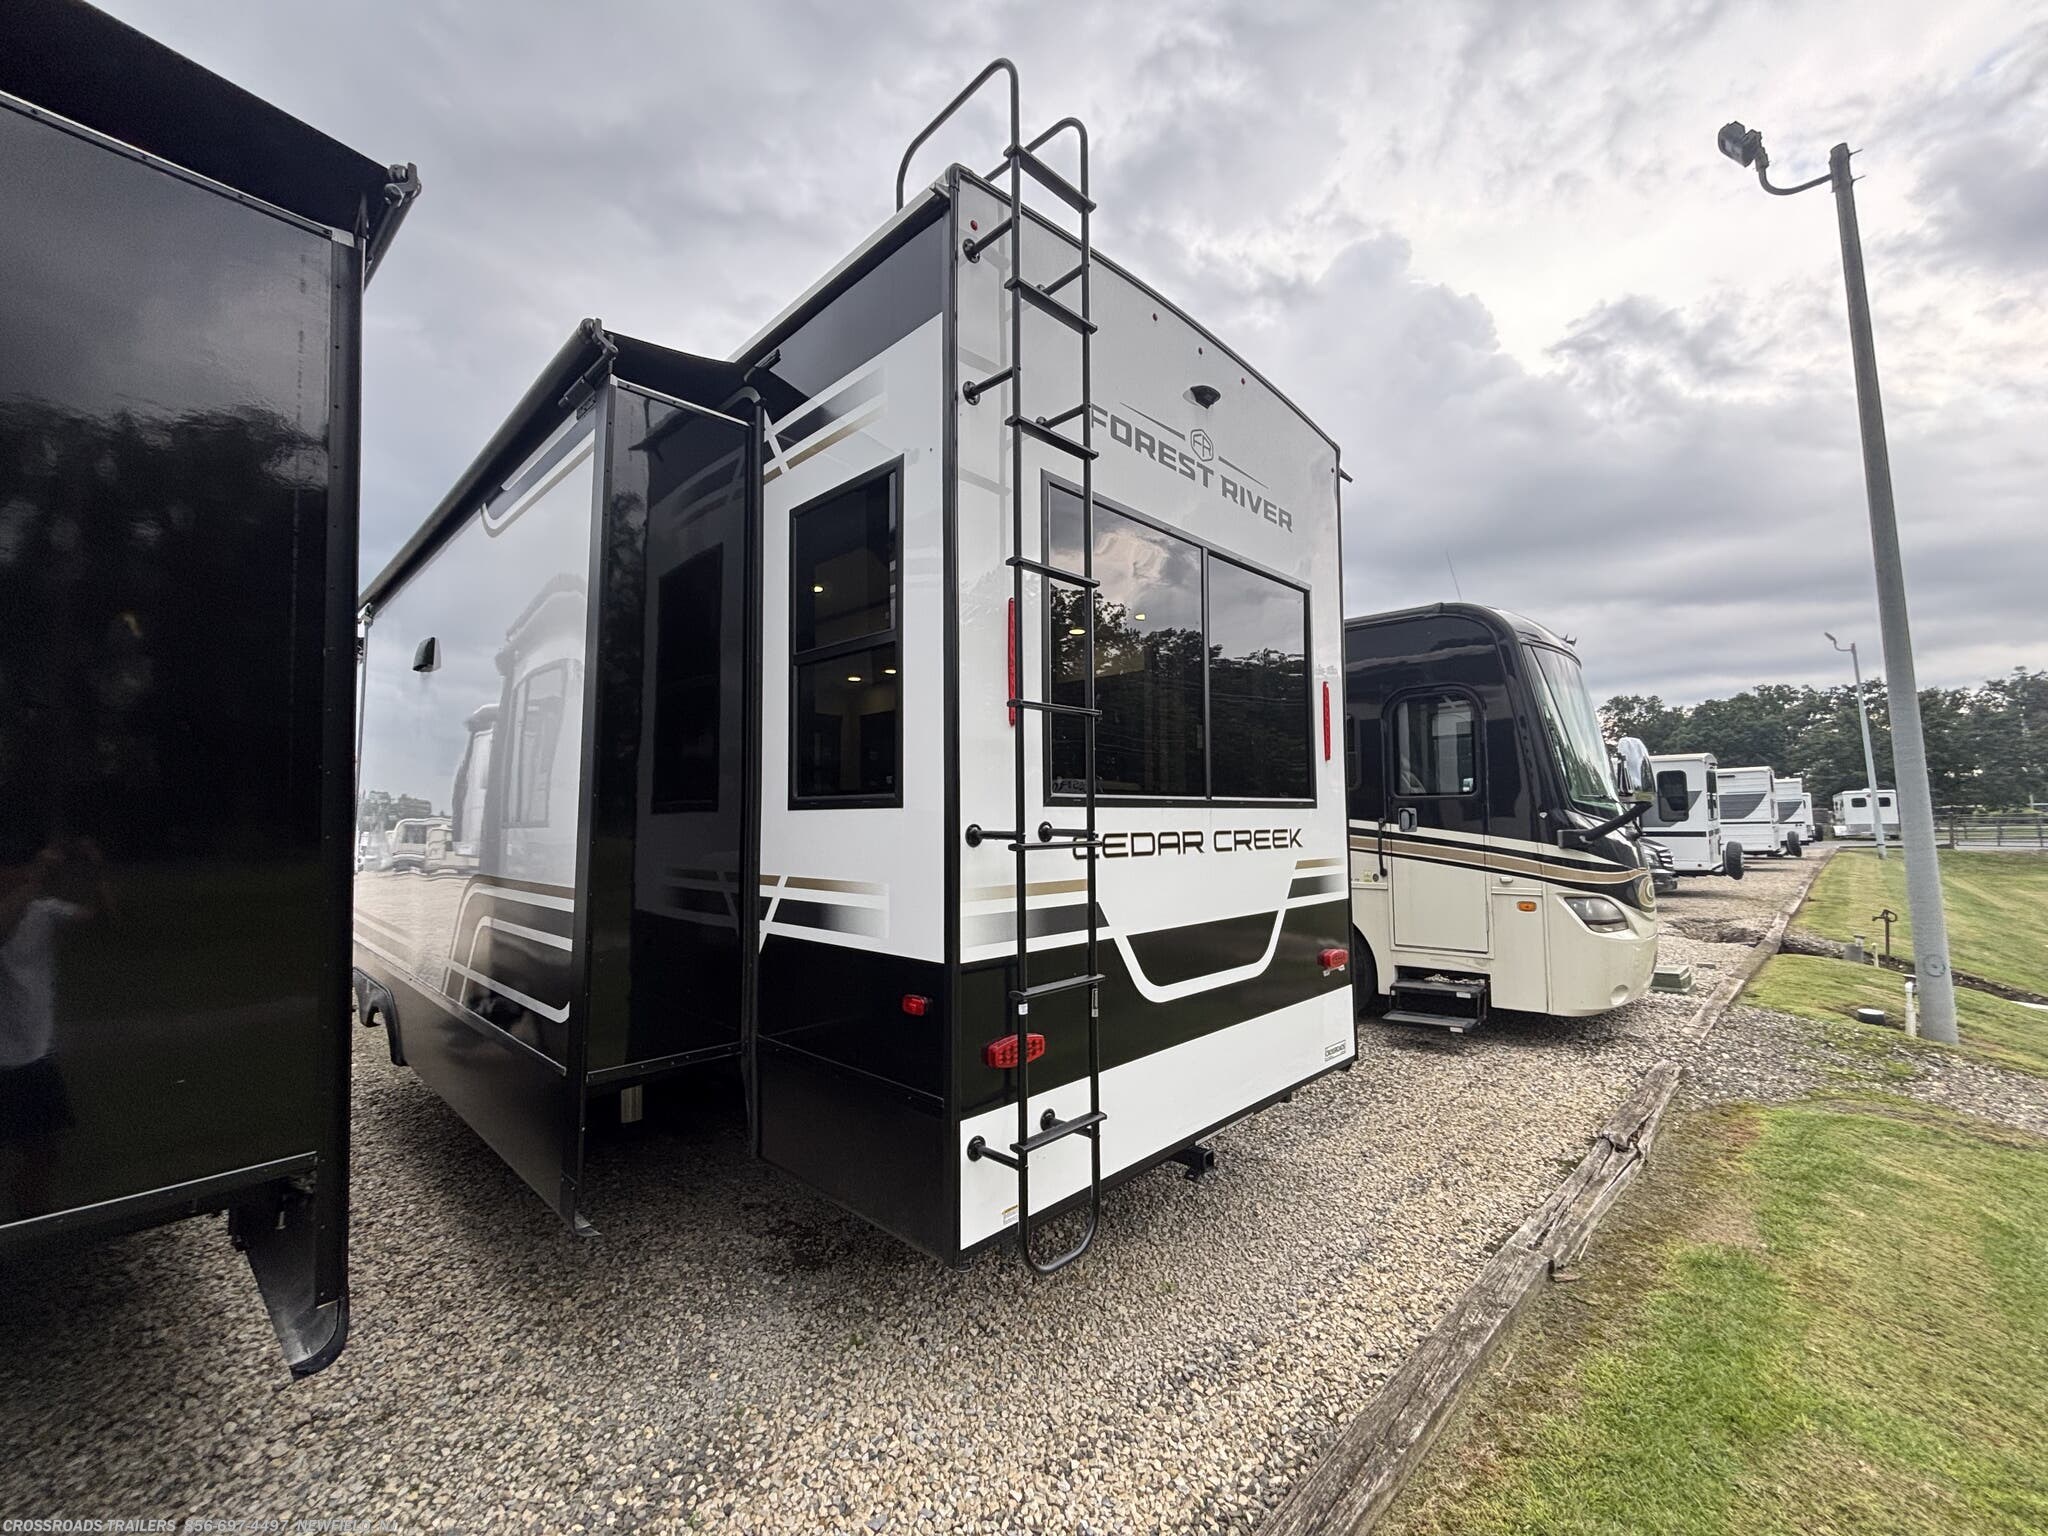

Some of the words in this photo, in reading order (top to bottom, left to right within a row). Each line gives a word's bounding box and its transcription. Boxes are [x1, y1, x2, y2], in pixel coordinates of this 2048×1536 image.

[1091, 402, 1214, 488] FOREST
[1220, 474, 1294, 533] RIVER
[1213, 828, 1303, 852] CREEK
